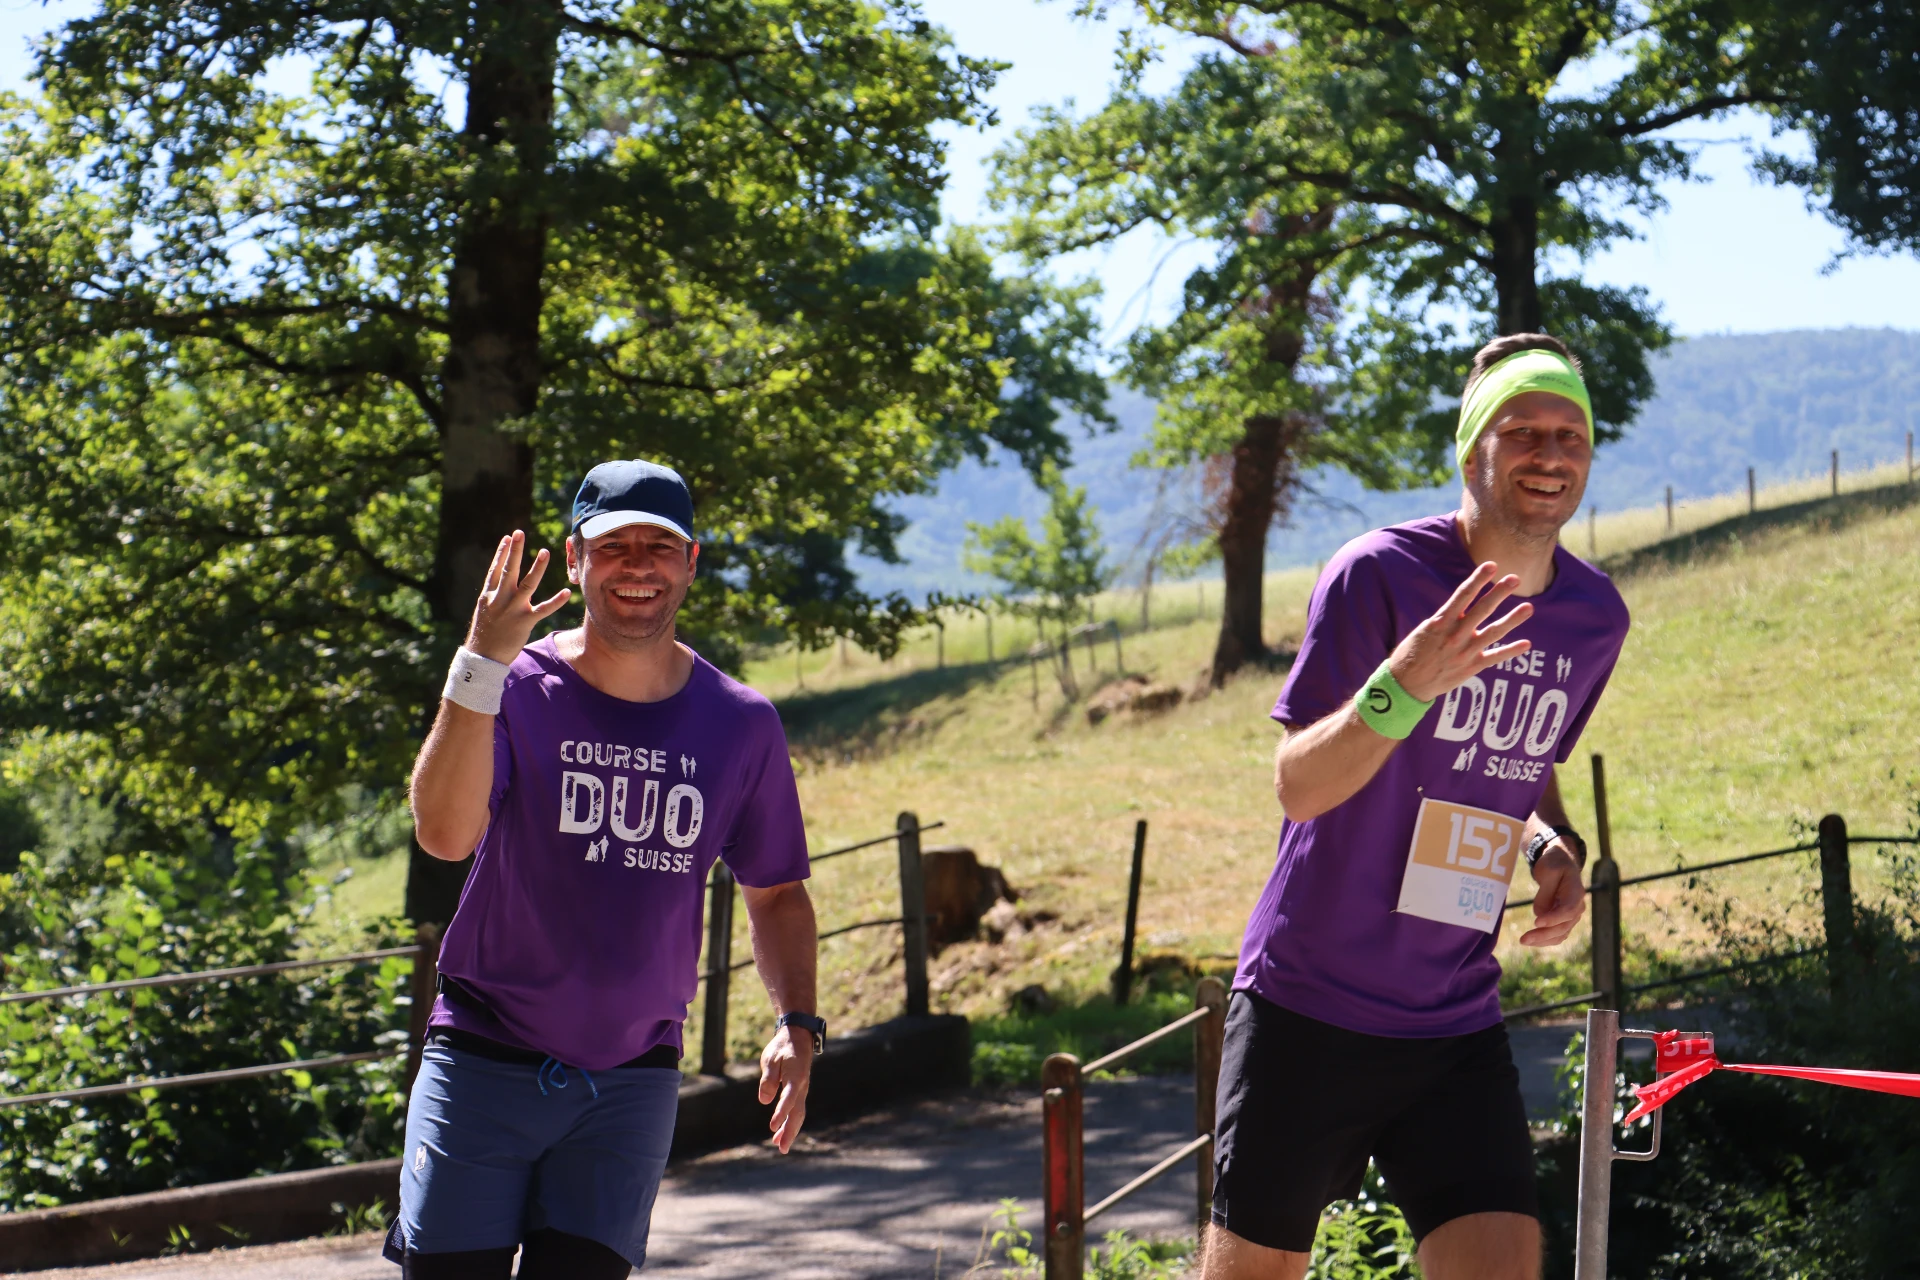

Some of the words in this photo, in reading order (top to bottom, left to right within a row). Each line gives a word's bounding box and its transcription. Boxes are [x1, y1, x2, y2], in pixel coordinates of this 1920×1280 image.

[1433, 675, 1568, 757] DUO
[560, 740, 667, 773] COURSE
[1484, 755, 1546, 782] SUISSE
[558, 770, 704, 848] DUO
[623, 847, 694, 873] SUISSE
[1445, 812, 1512, 877] 152
[1458, 886, 1494, 913] DUO
